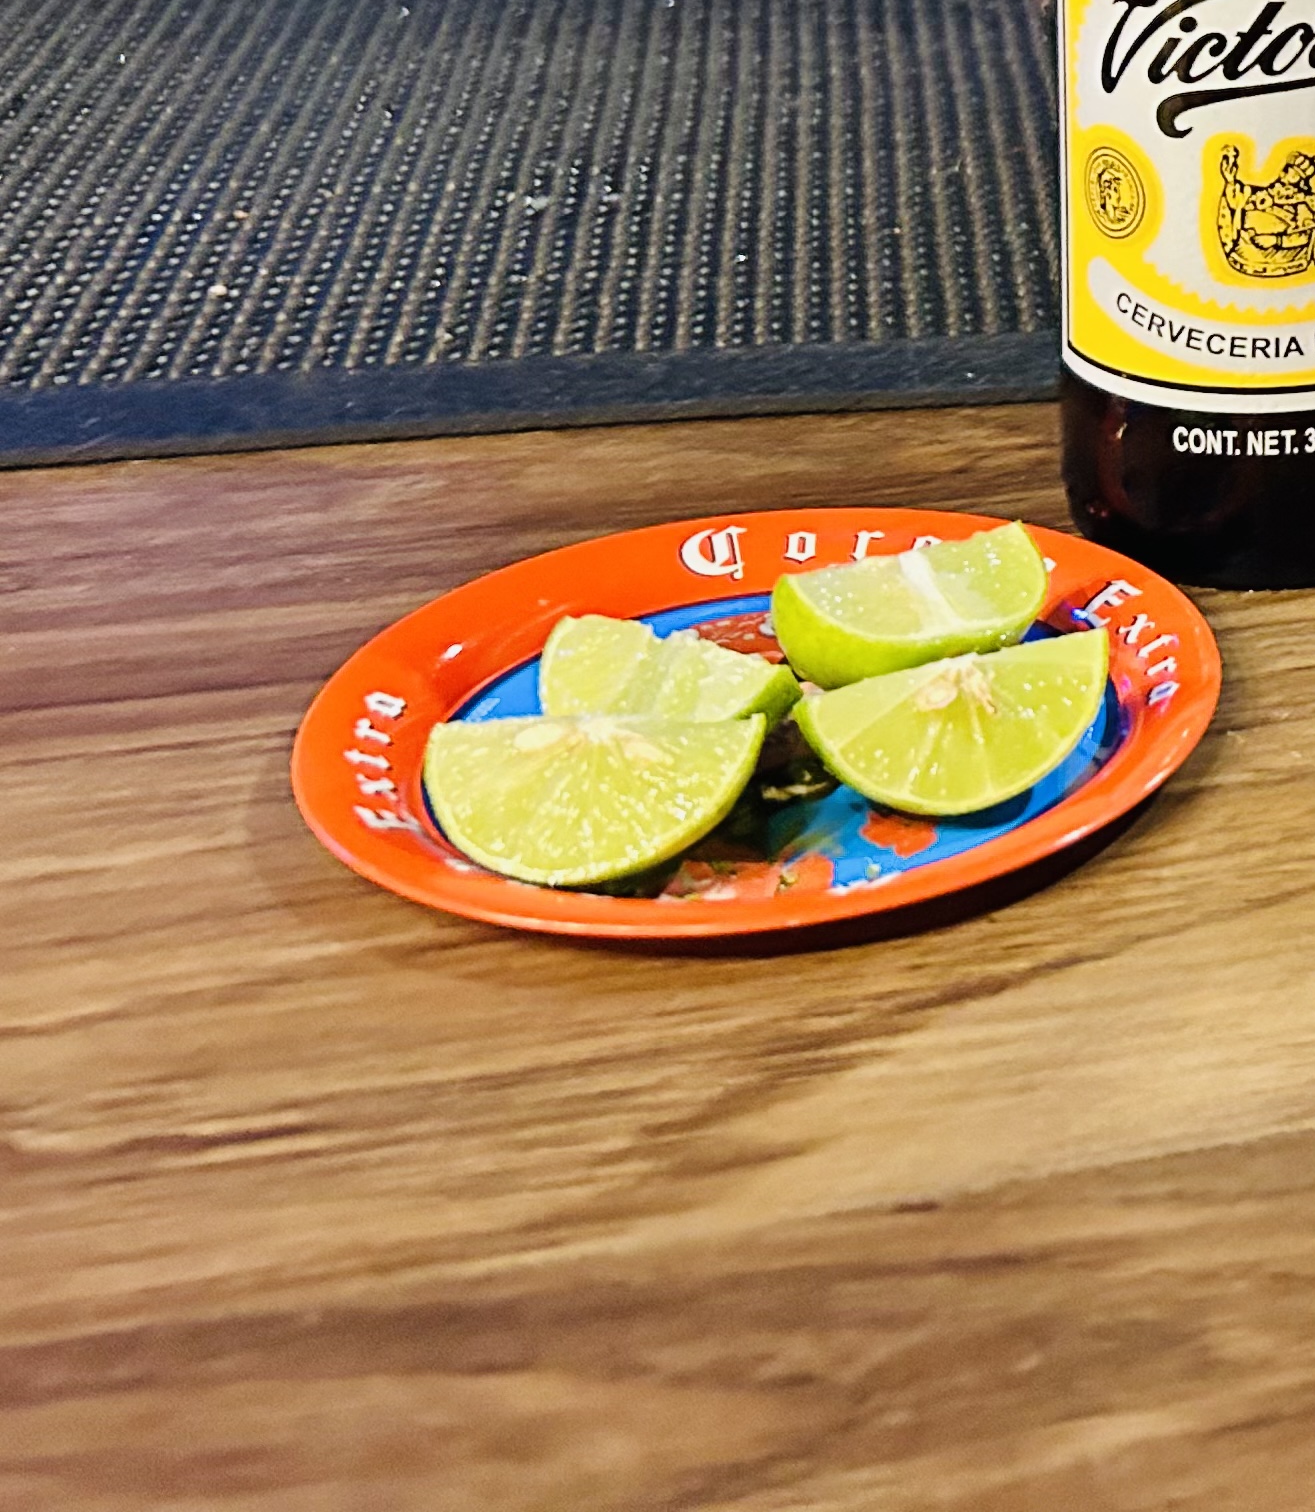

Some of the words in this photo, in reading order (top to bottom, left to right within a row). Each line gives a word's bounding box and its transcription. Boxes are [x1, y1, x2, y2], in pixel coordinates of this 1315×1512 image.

[1115, 292, 1304, 359] CERVECERIA
[1172, 425, 1241, 457] CONT.
[1246, 429, 1300, 457] NET.
[1080, 579, 1180, 706] Extra
[343, 691, 424, 838] Extra
